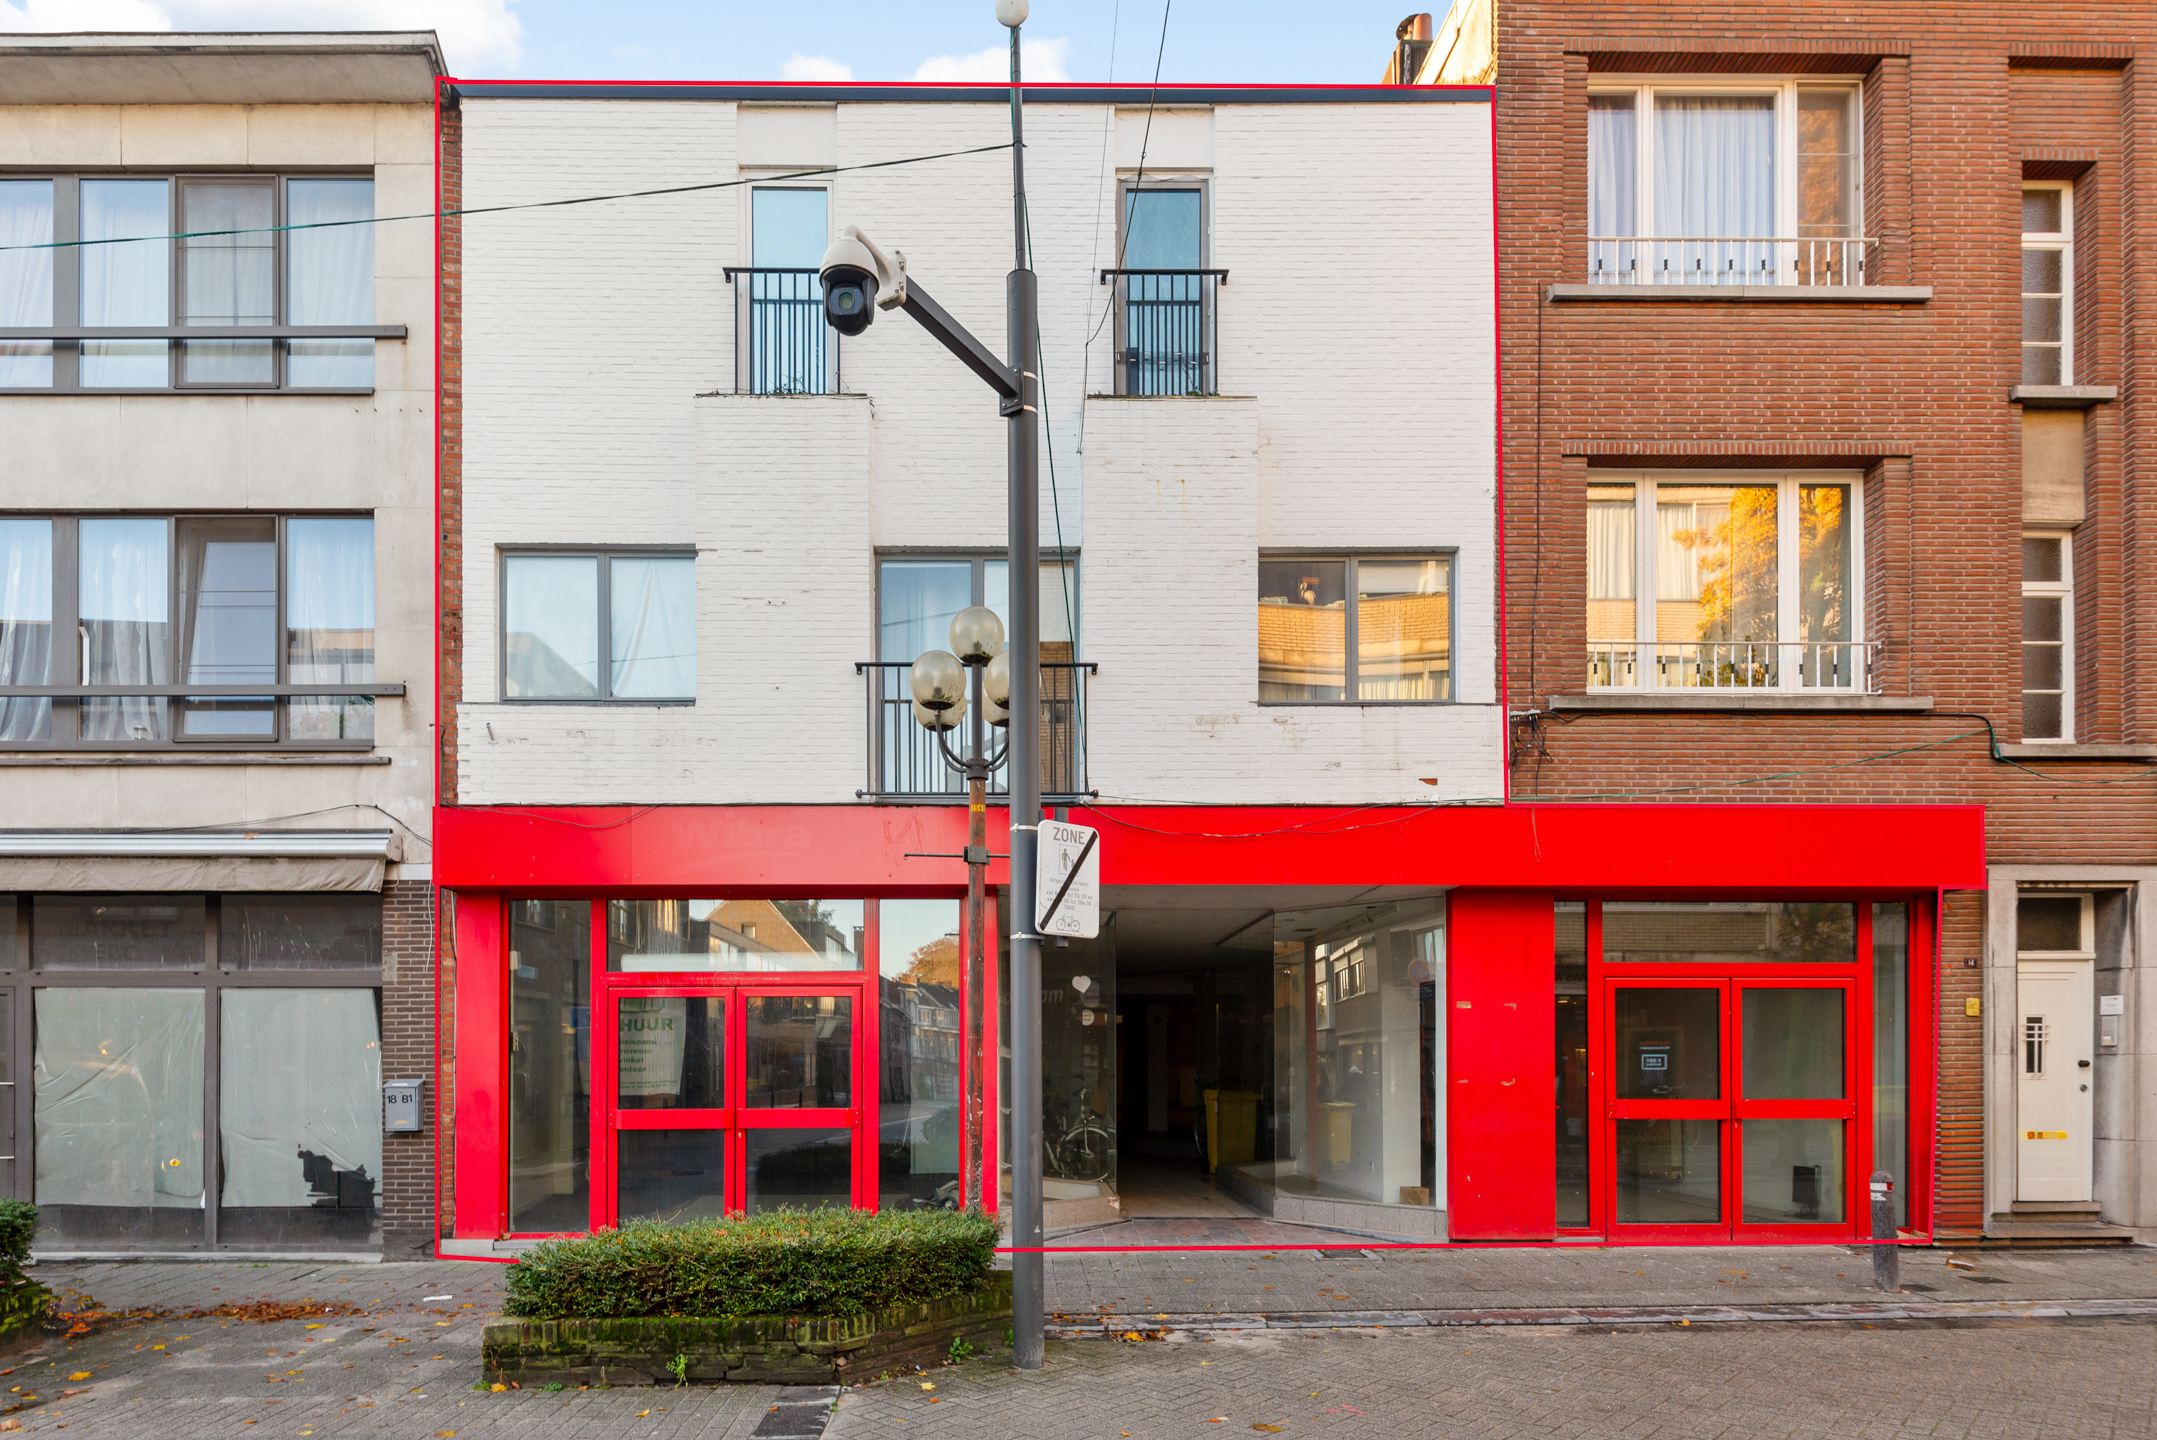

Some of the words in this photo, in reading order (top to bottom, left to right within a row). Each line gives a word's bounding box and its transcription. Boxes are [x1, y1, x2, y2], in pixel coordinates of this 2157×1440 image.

[1053, 827, 1086, 845] ZONE
[620, 1018, 674, 1031] HUUR
[387, 1095, 397, 1104] 18
[402, 1094, 413, 1103] B1
